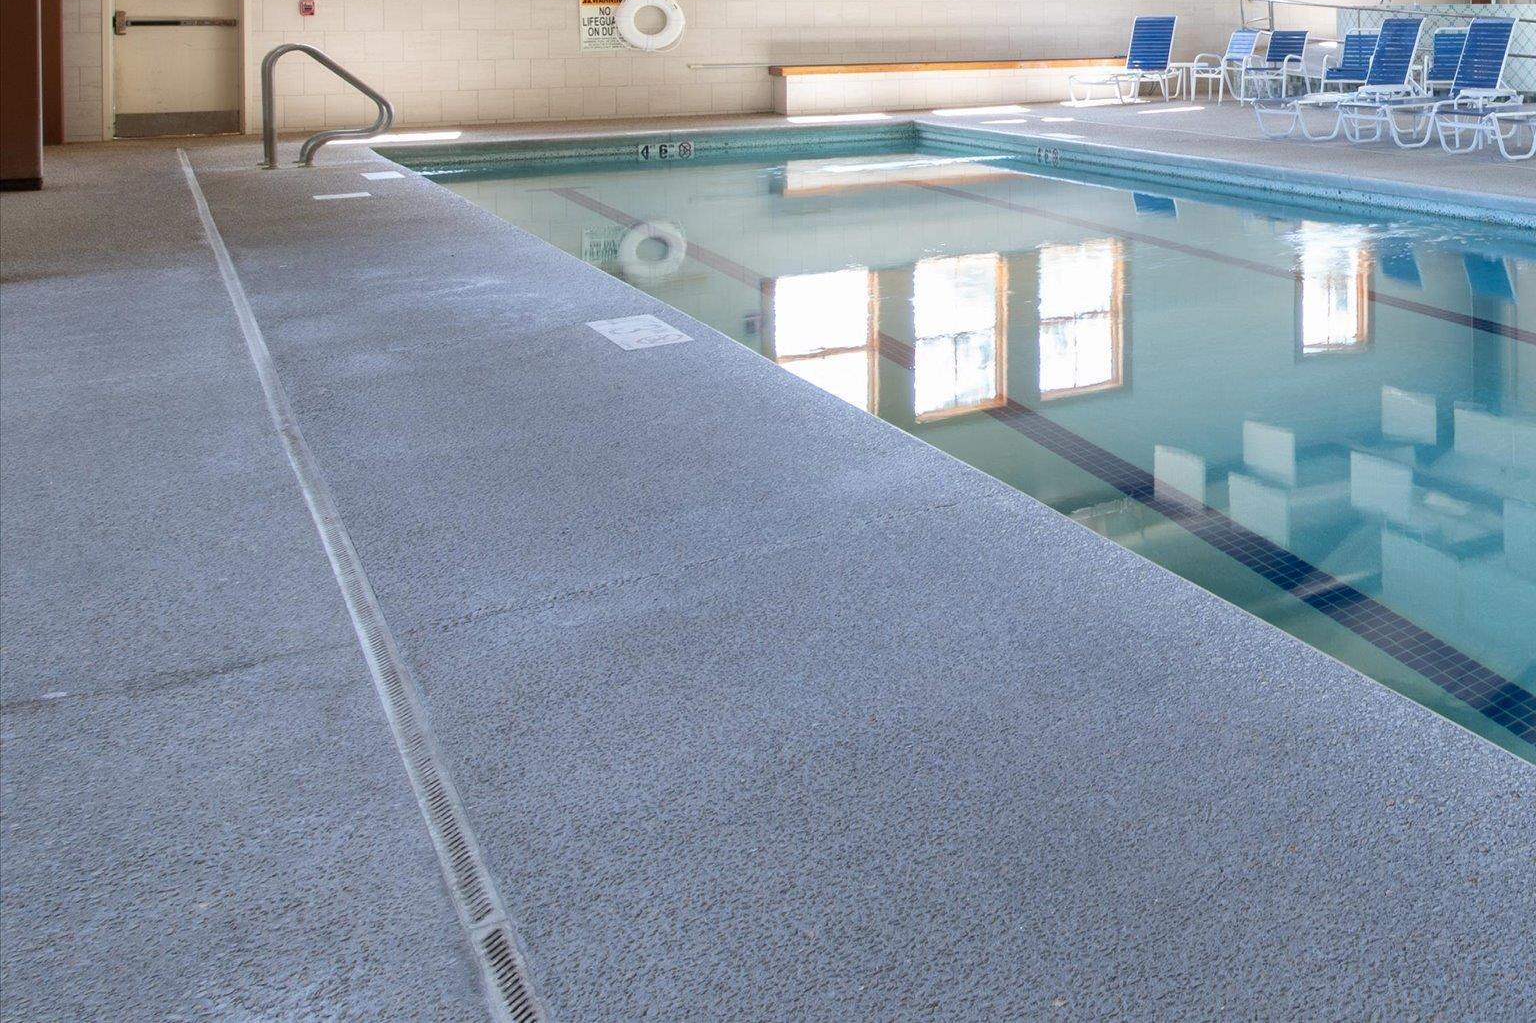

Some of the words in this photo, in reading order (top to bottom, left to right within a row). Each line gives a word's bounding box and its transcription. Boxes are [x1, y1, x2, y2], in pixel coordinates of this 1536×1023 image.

[599, 6, 611, 16] NO
[582, 16, 616, 27] LIFEGUA
[588, 27, 600, 37] ON
